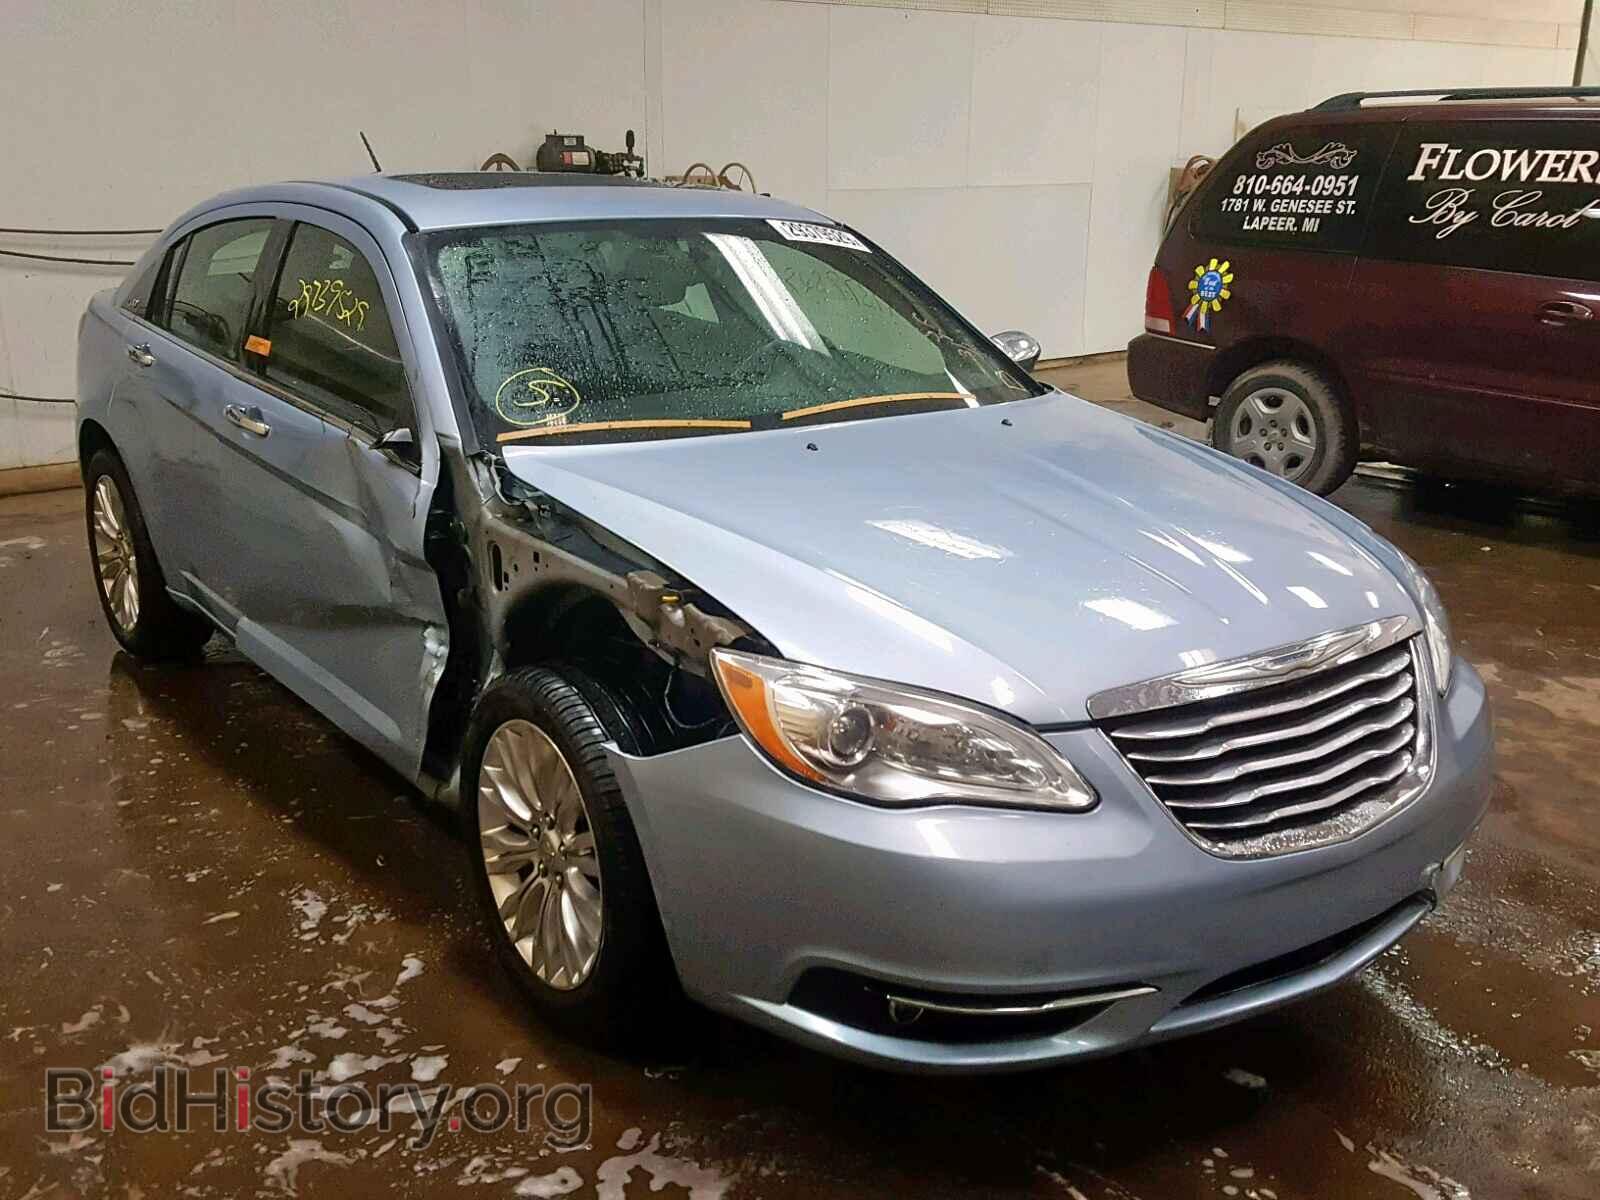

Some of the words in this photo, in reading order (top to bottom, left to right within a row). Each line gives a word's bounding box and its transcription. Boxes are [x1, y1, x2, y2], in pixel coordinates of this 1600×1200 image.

[1407, 143, 1600, 183] FLOWER
[1232, 174, 1359, 196] 810-664-0951
[1221, 198, 1249, 212] 1781
[1252, 199, 1266, 212] W.
[1270, 199, 1333, 214] GENESEE
[1335, 200, 1356, 215] ST.
[1408, 188, 1480, 239] By
[1491, 190, 1600, 228] Carol
[1301, 217, 1320, 233] MI
